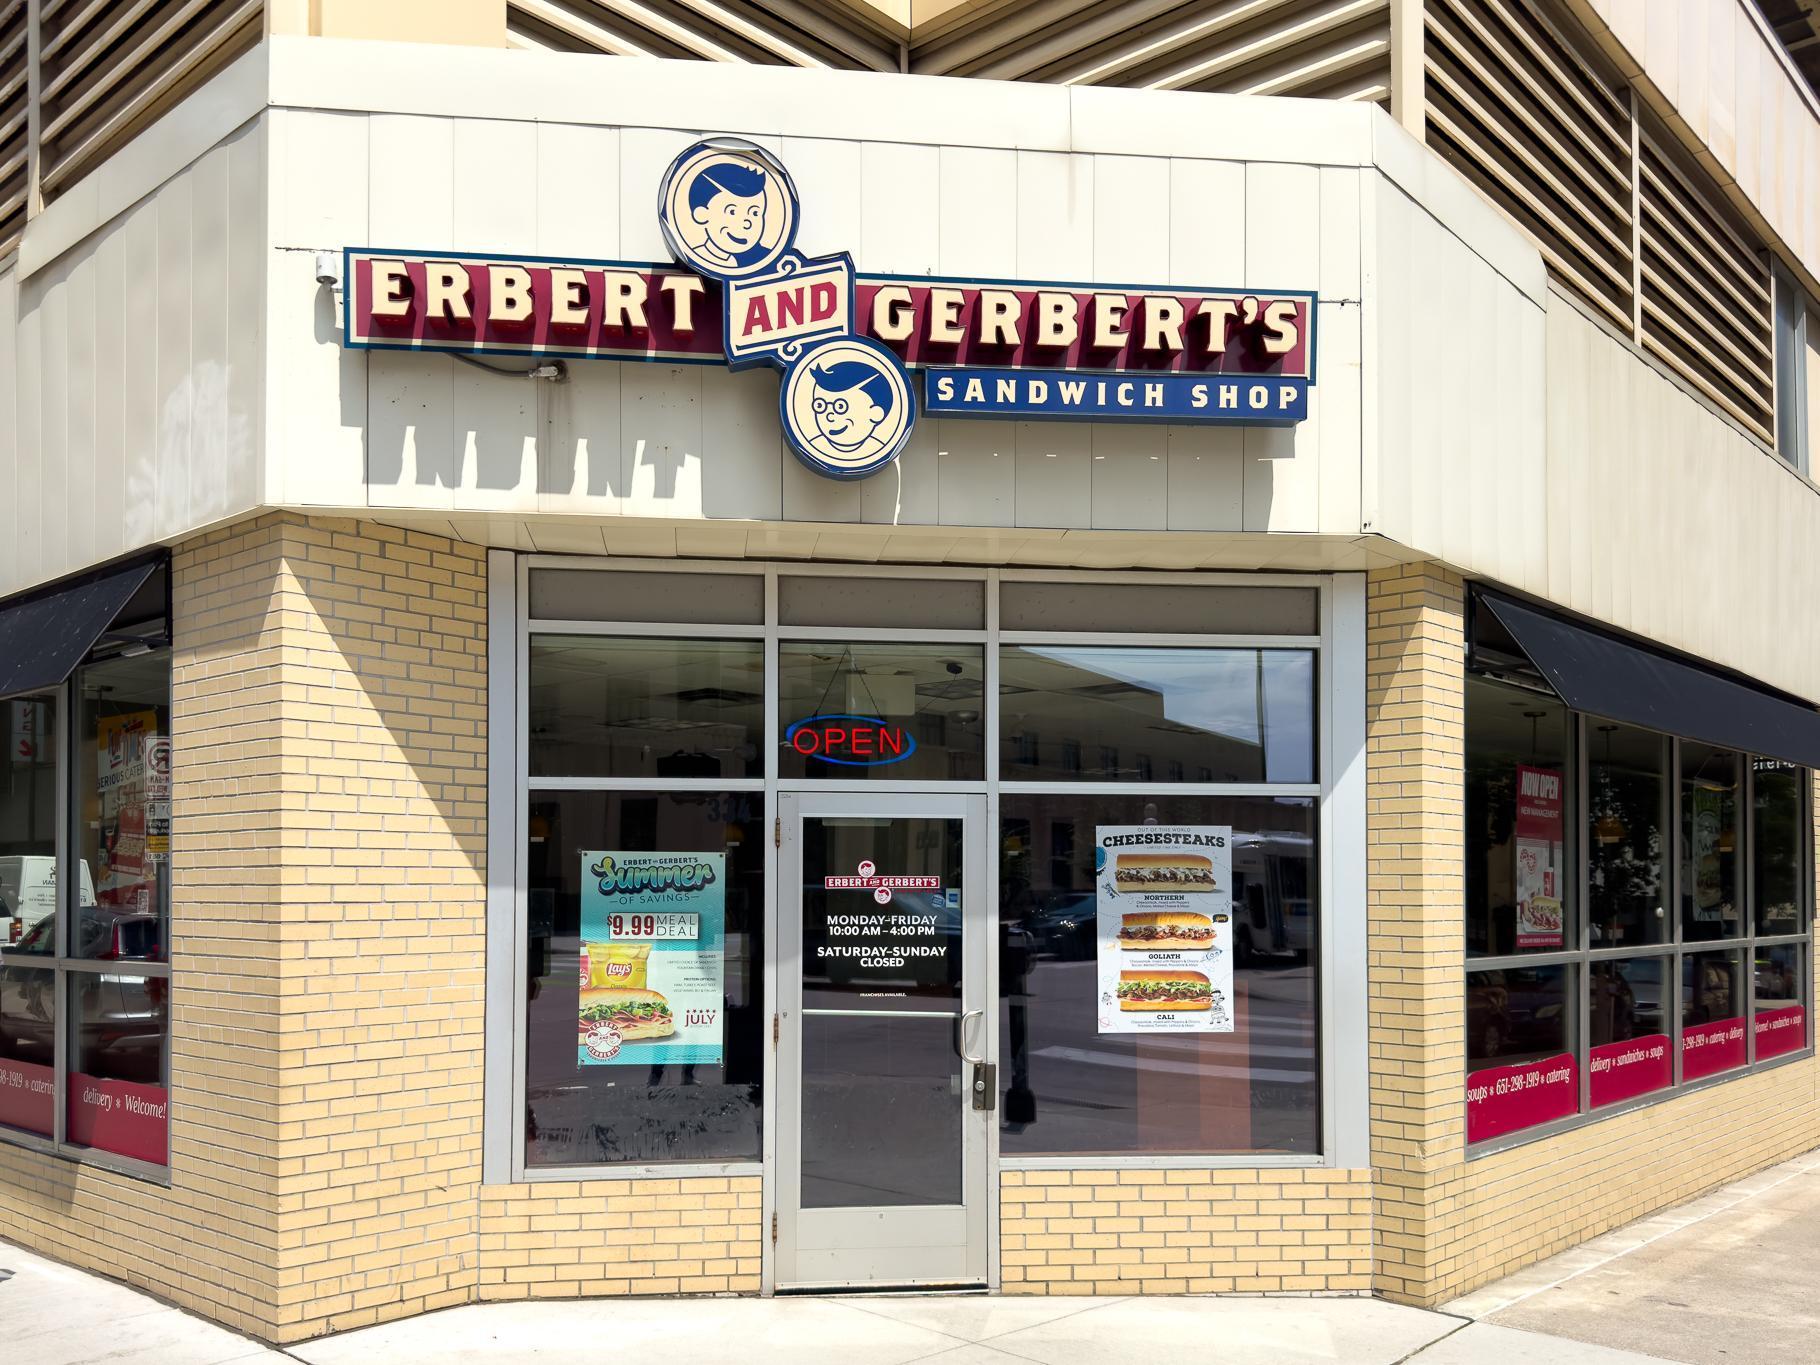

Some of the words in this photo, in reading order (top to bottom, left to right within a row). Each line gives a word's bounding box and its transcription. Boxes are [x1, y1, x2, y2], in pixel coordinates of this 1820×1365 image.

[369, 258, 706, 332] ERBERT
[742, 281, 838, 337] AND
[873, 284, 1299, 354] GERBERT'S
[937, 377, 1165, 407] SANDWICH
[1190, 384, 1299, 410] SHOP
[793, 727, 901, 755] OPEN
[1520, 771, 1541, 798] NOW
[1540, 774, 1560, 800] OPEN
[1102, 833, 1225, 848] CHEESESTEAKS
[623, 858, 651, 866] ERBERT
[591, 856, 716, 896] Summer
[828, 878, 868, 887] ERBERT
[881, 878, 937, 887] GERBERT'S
[619, 896, 635, 905] OF
[640, 893, 690, 904] SAVINGS
[607, 914, 655, 936] $9.99
[656, 915, 696, 926] MEAL
[656, 926, 696, 937] DEAL
[829, 926, 860, 936] 10:00
[861, 926, 881, 936] AM
[889, 926, 916, 936] 4:00
[917, 926, 935, 936] PM
[607, 962, 632, 977] Lay's
[860, 957, 905, 967] CLOSED
[684, 1014, 716, 1027] JULY
[1792, 1015, 1802, 1026] soups
[1709, 1030, 1726, 1045] catering
[1729, 1026, 1744, 1040] delivery
[1590, 1056, 1612, 1073] delivery
[1616, 1048, 1645, 1067] sandwiches
[1649, 1045, 1664, 1060] soups
[1466, 1086, 1489, 1104] soups
[1495, 1070, 1541, 1096] 651-298-1919
[1546, 1066, 1571, 1084] catering
[83, 1086, 113, 1112] delivery
[124, 1094, 167, 1119] Welcome!
